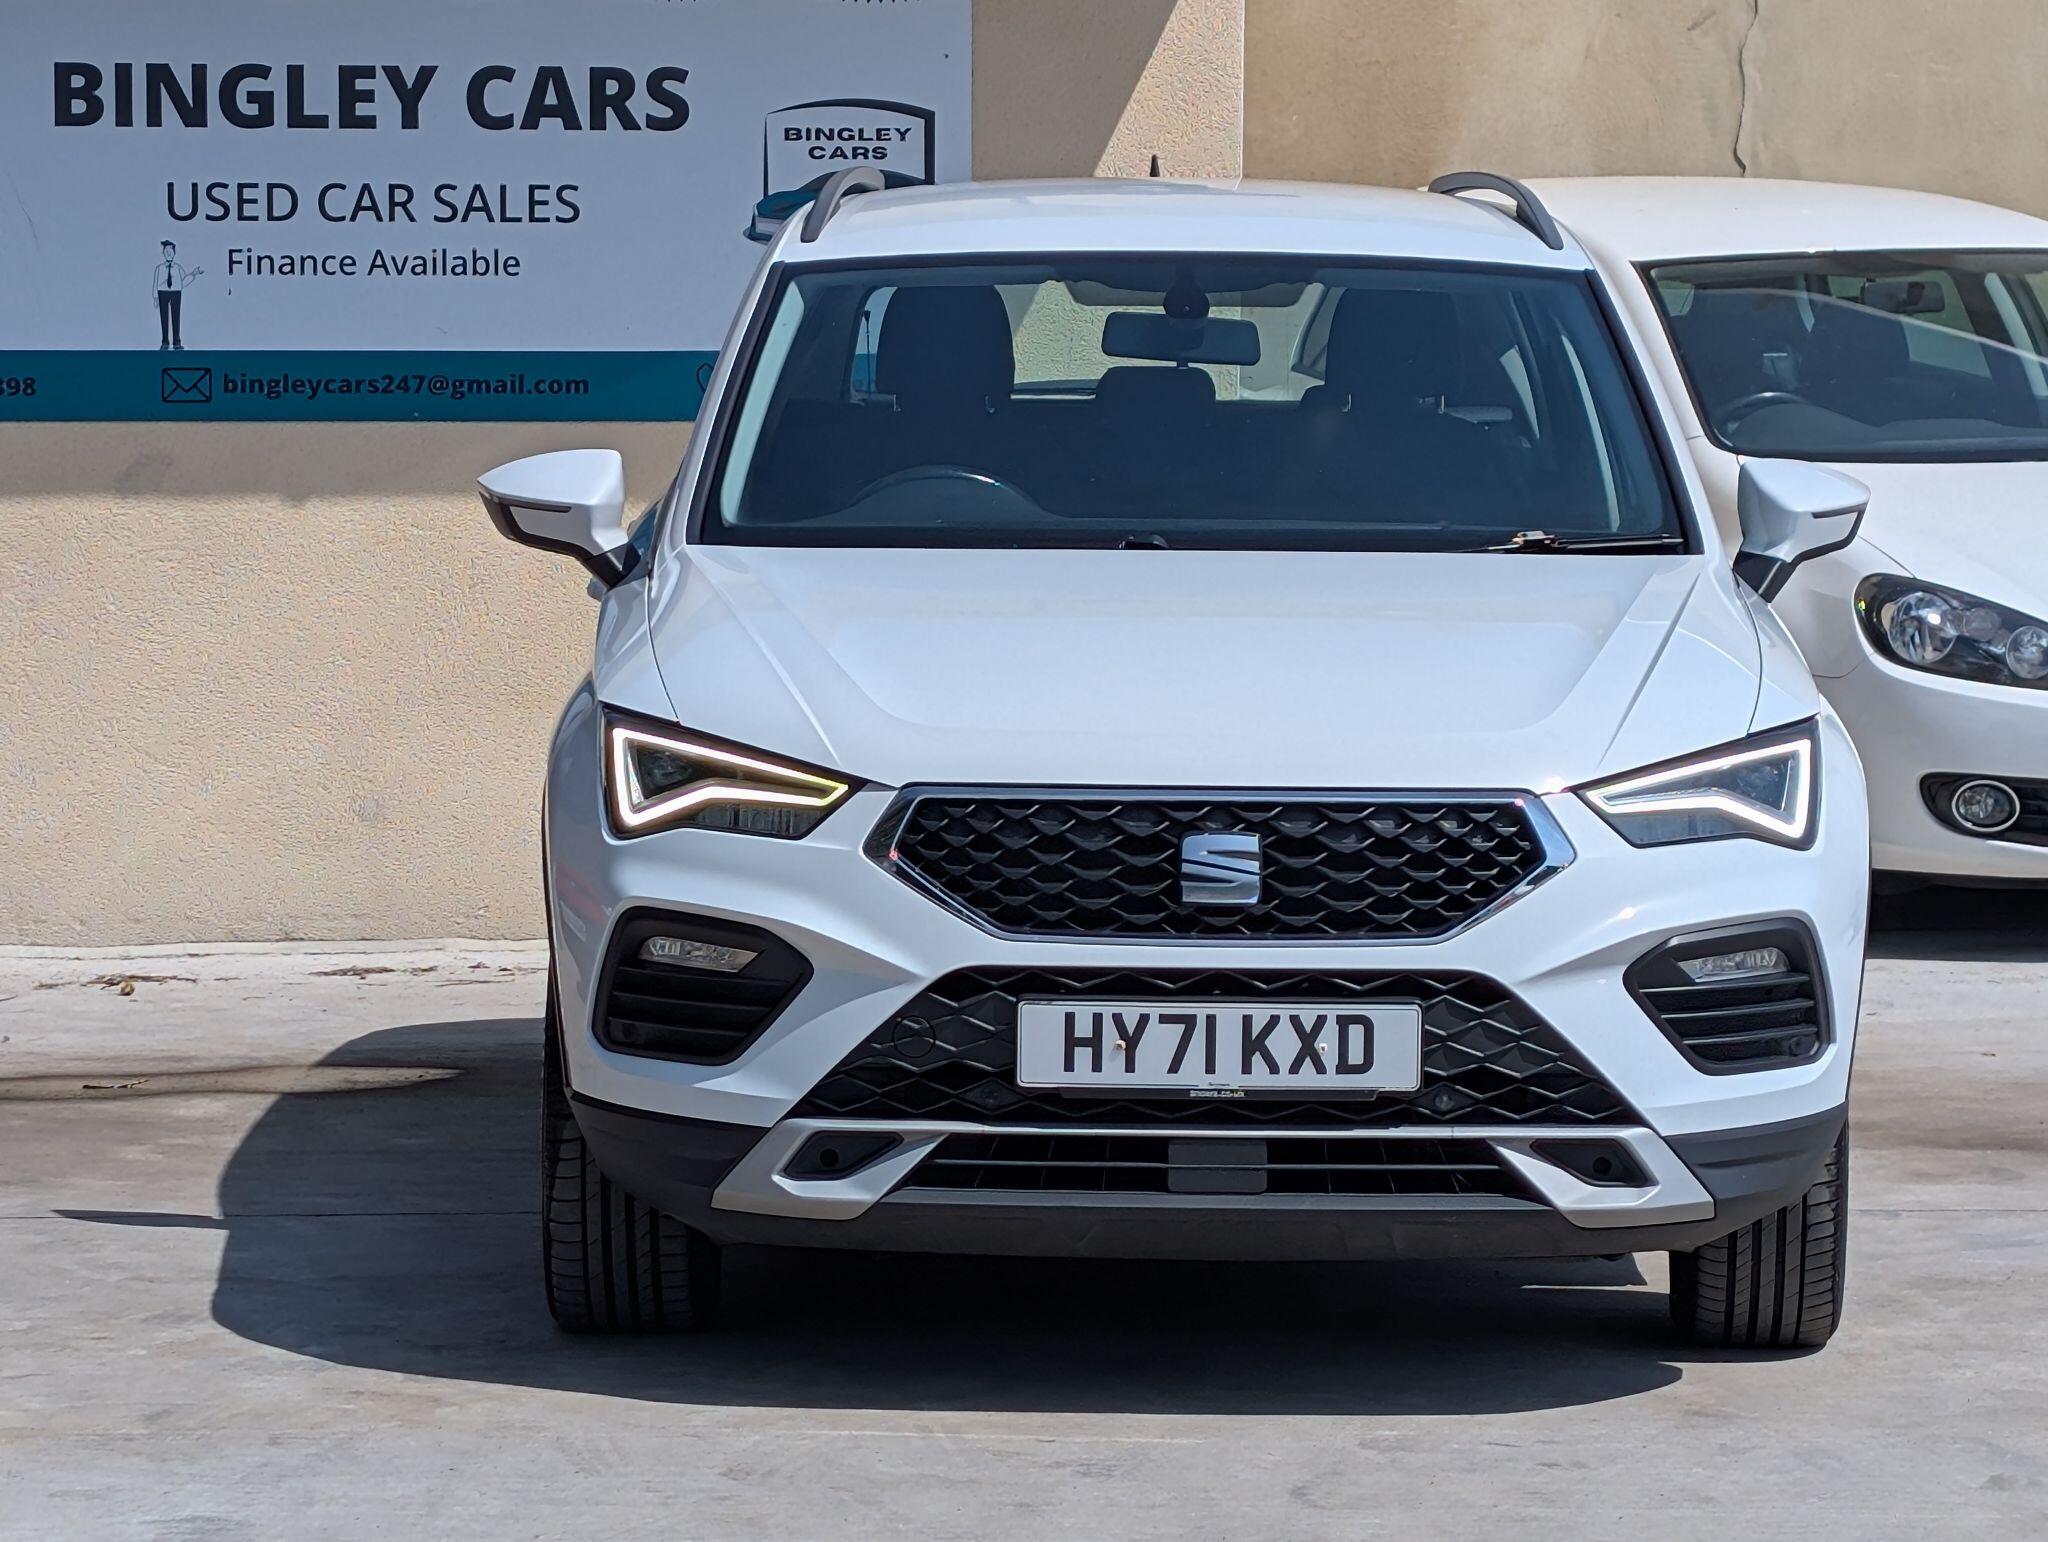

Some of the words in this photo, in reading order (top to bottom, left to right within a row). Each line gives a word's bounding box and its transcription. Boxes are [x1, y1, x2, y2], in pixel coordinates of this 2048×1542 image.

[54, 62, 438, 129] BINGLEY
[467, 65, 690, 131] CARS
[784, 127, 912, 141] BINGLEY
[808, 146, 888, 160] CARS
[167, 182, 299, 222] USED
[318, 183, 417, 223] CAR
[433, 184, 581, 223] SALES
[228, 248, 356, 276] Finance
[367, 248, 521, 276] Available
[224, 373, 589, 400] bingleycars247@gmail.com
[1063, 1012, 1217, 1075] HY71
[1241, 1014, 1375, 1075] KXD
